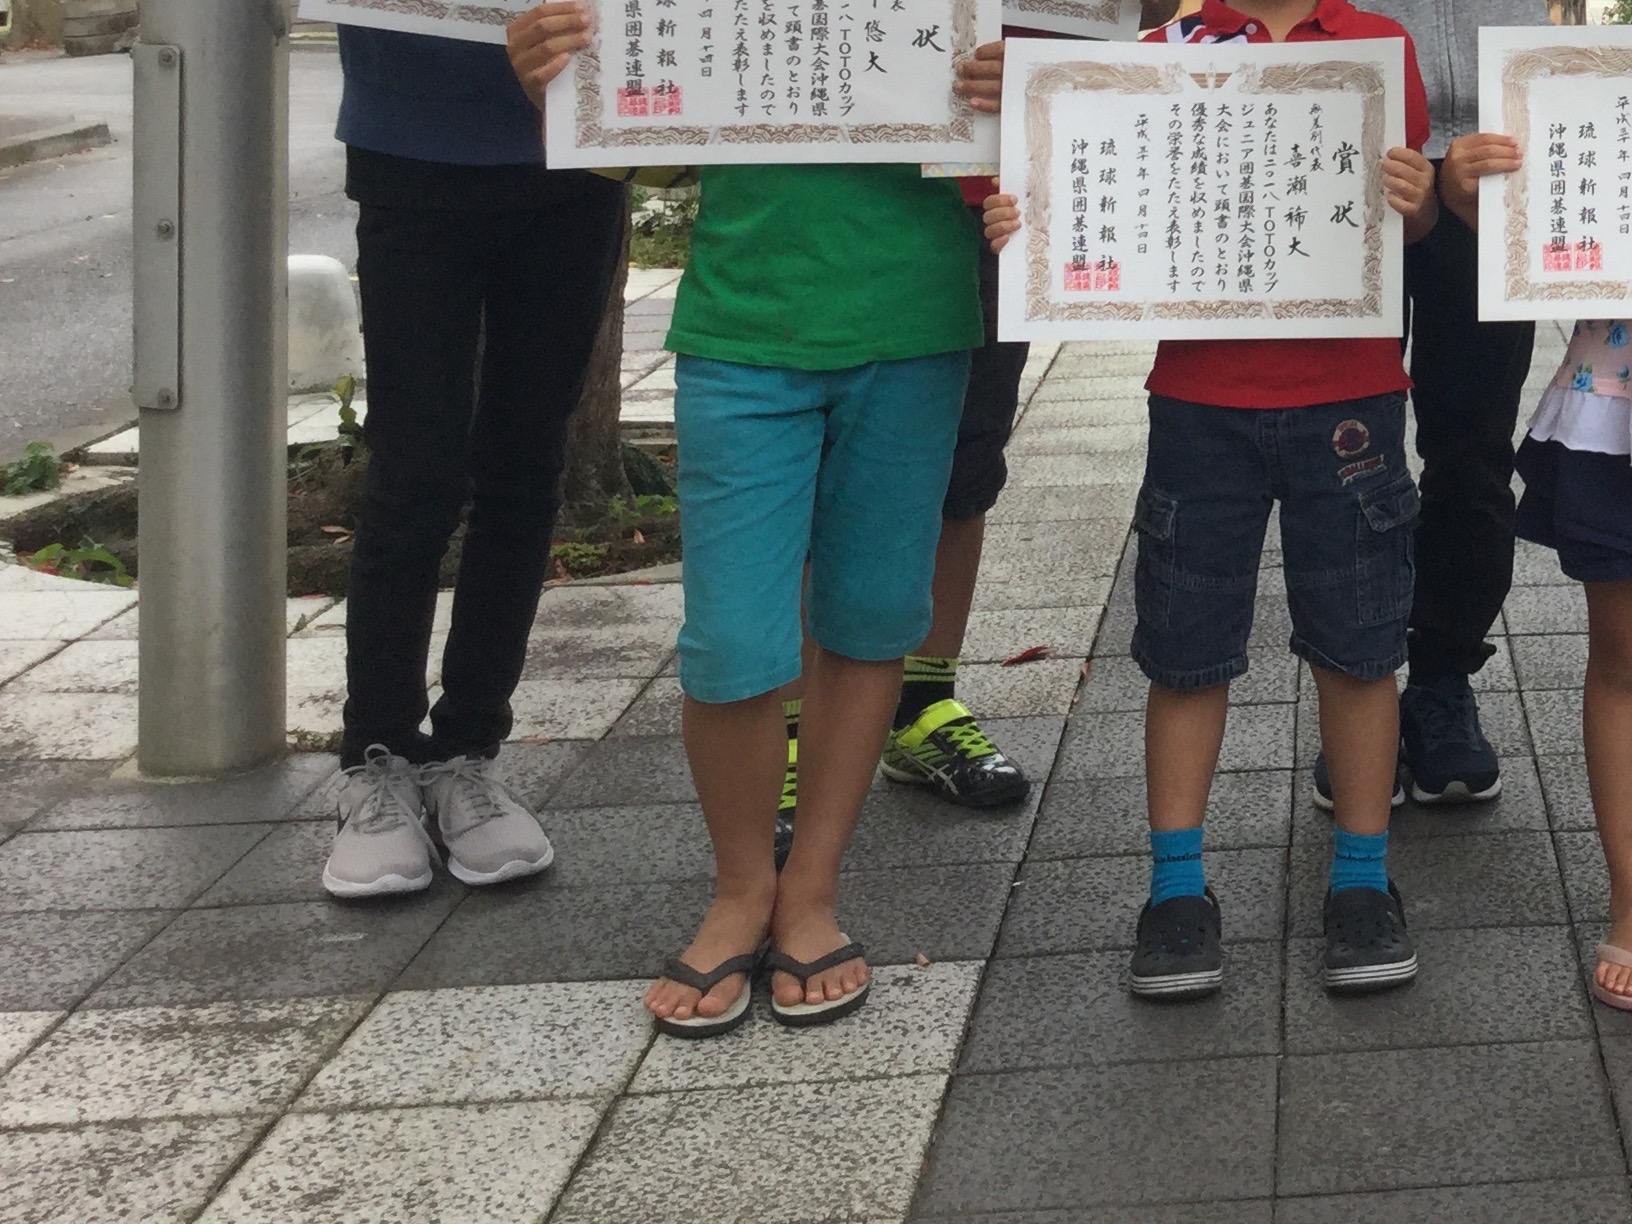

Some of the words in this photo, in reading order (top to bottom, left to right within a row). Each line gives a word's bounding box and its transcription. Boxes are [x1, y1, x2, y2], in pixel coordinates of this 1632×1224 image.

[1071, 139, 1089, 271] 沖縄県囲碁連盟
[1098, 138, 1117, 271] 琉球新報社
[1165, 104, 1182, 293] その栄誉をたたえ表彰します
[1190, 102, 1207, 293] 優秀な成績を収めましたので
[1214, 104, 1232, 292] 大会において頭書のとおり
[1238, 104, 1254, 292] ジュニア囲碁国際大会沖縄県
[1330, 141, 1359, 227] 賞状
[1548, 123, 1567, 252] 沖縄県囲碁連盟
[1578, 122, 1597, 251] 琉球新報社
